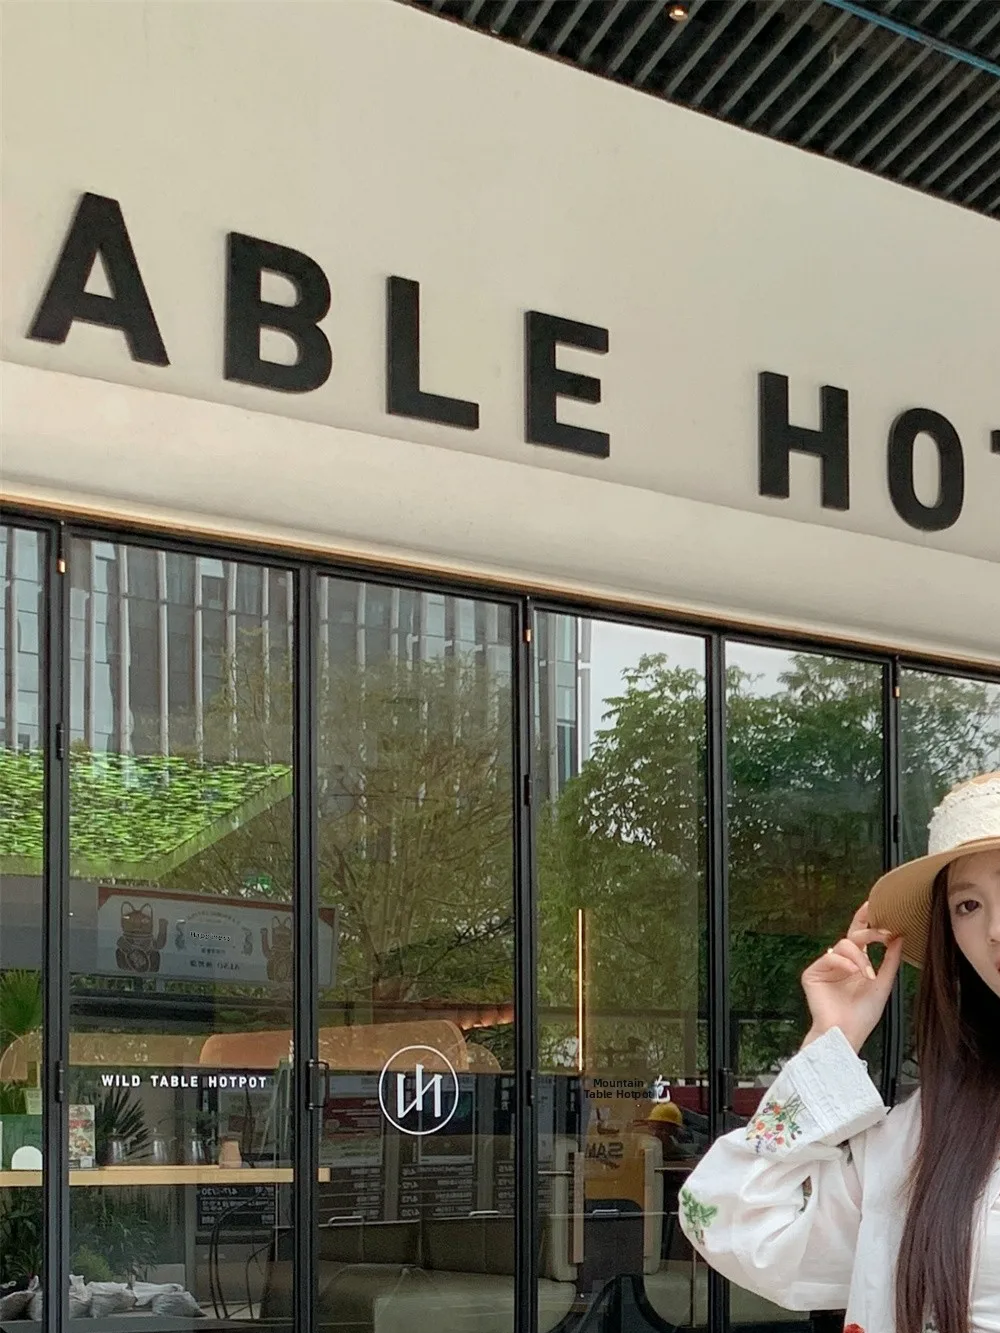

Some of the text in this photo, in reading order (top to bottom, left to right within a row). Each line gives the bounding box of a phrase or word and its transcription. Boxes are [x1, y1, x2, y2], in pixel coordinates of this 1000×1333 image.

[25, 191, 610, 460] ABLE
[101, 1074, 267, 1089] WILD TABLE HOTPOT
